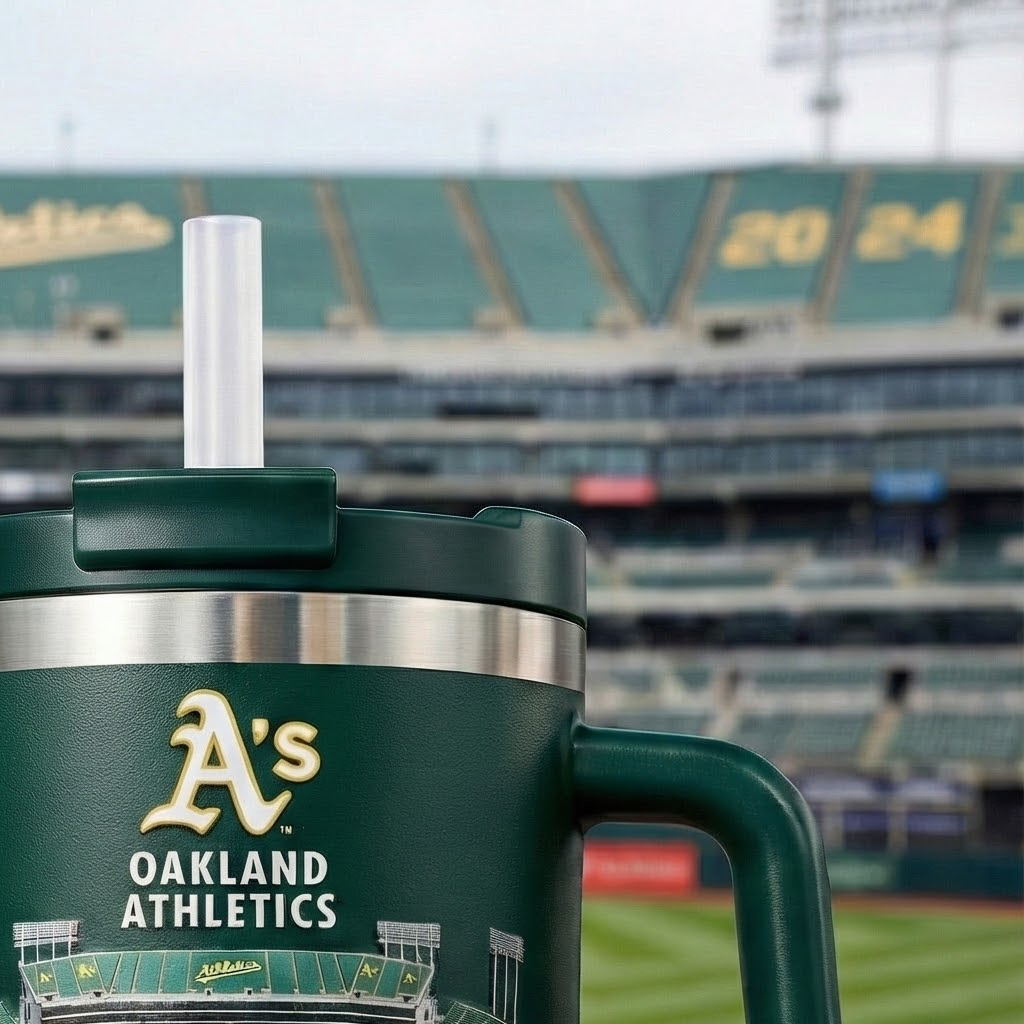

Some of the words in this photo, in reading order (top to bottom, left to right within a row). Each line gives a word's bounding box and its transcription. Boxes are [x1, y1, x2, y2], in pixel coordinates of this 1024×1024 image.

[139, 689, 321, 836] A's
[129, 850, 328, 886] OAKLAND
[121, 893, 337, 929] ATHLETICS
